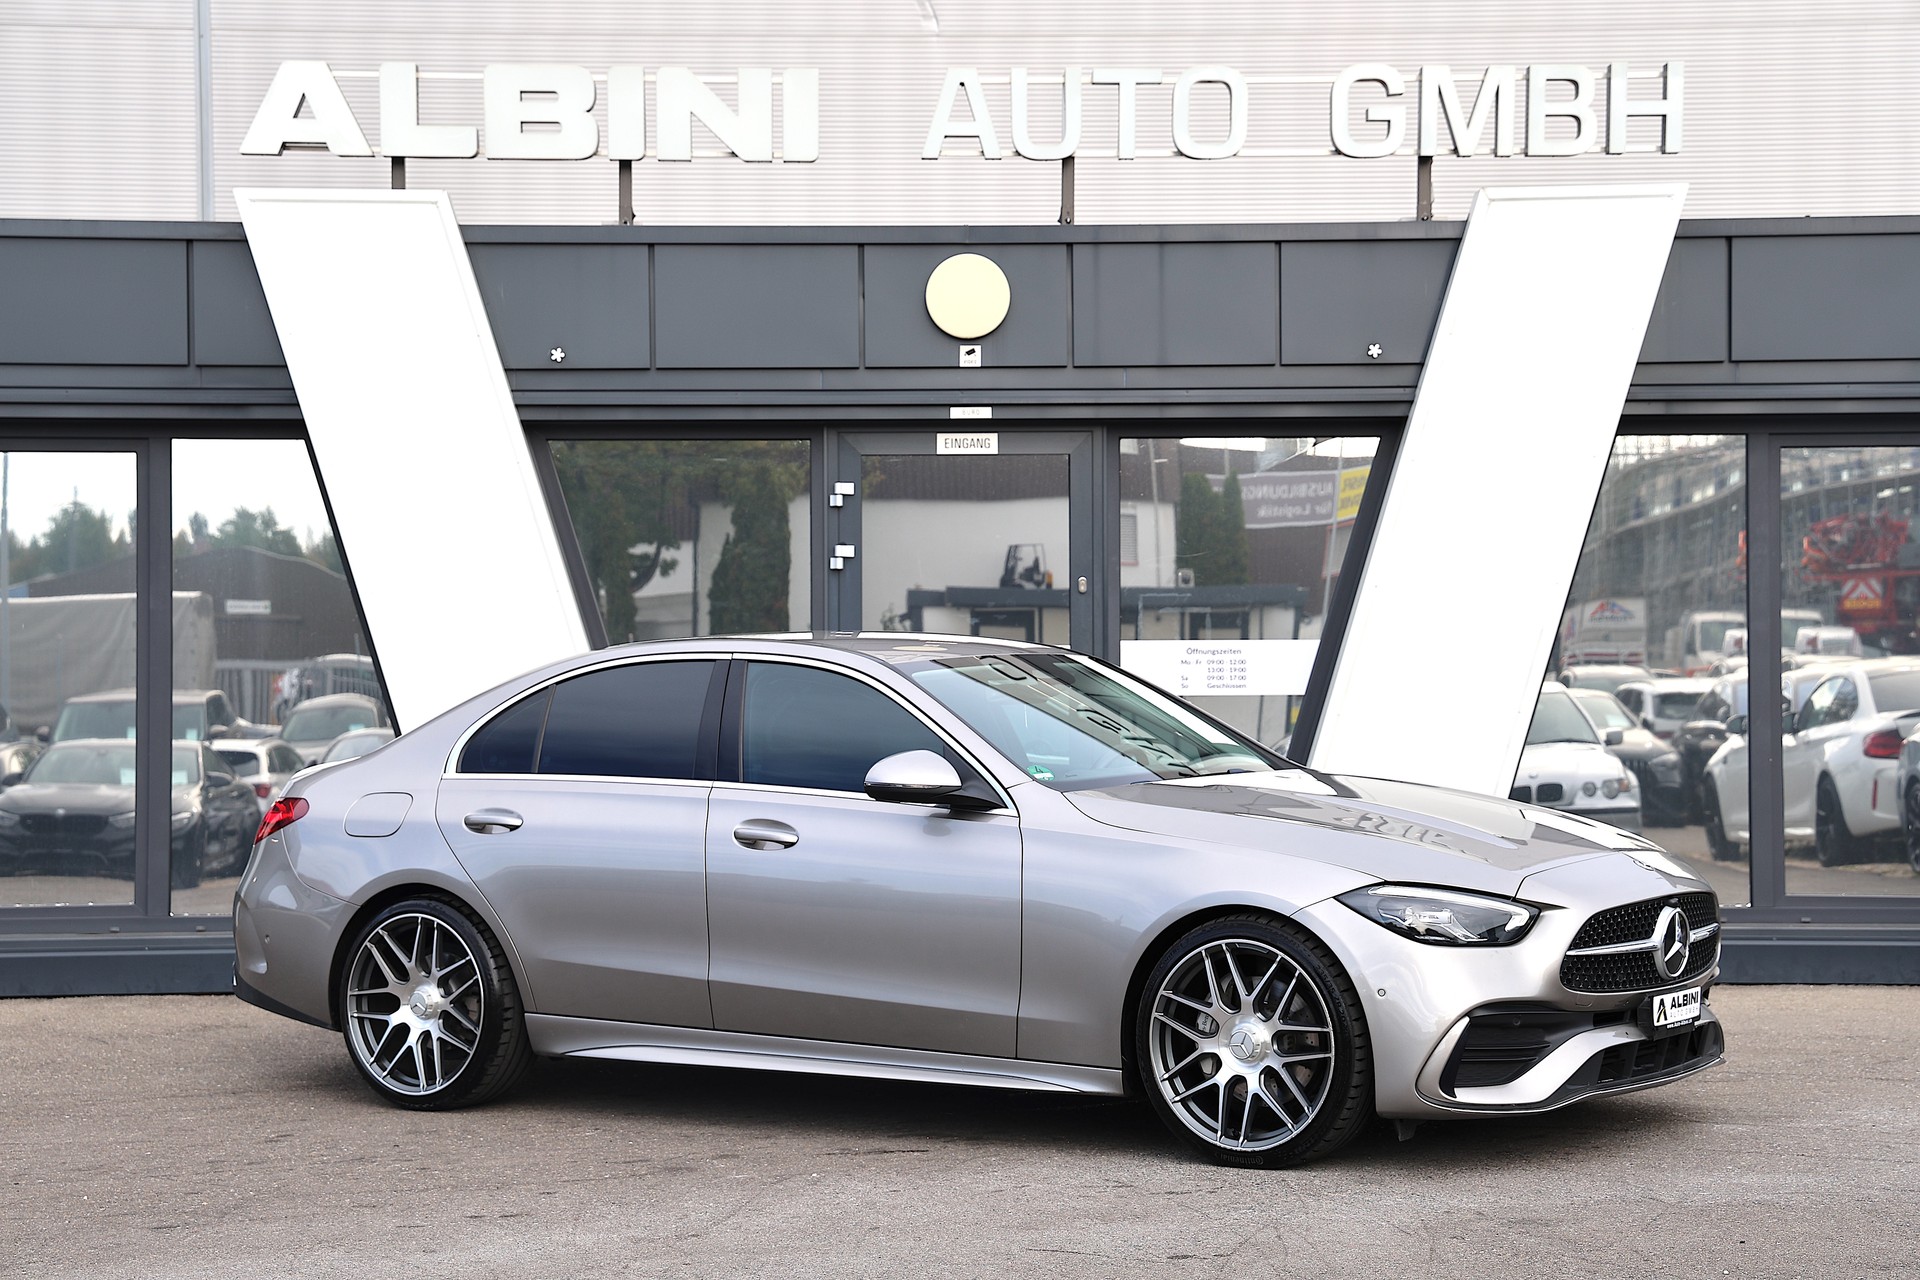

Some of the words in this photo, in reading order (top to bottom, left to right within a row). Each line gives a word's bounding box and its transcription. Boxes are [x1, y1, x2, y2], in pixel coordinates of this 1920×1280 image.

[239, 60, 819, 163] ALBINI
[921, 66, 1249, 160] AUTO
[1329, 61, 1685, 158] GMBH
[944, 437, 991, 449] EINGANG
[1186, 646, 1242, 655] Öffnungszeiten
[1670, 991, 1699, 1010] ALBINI
